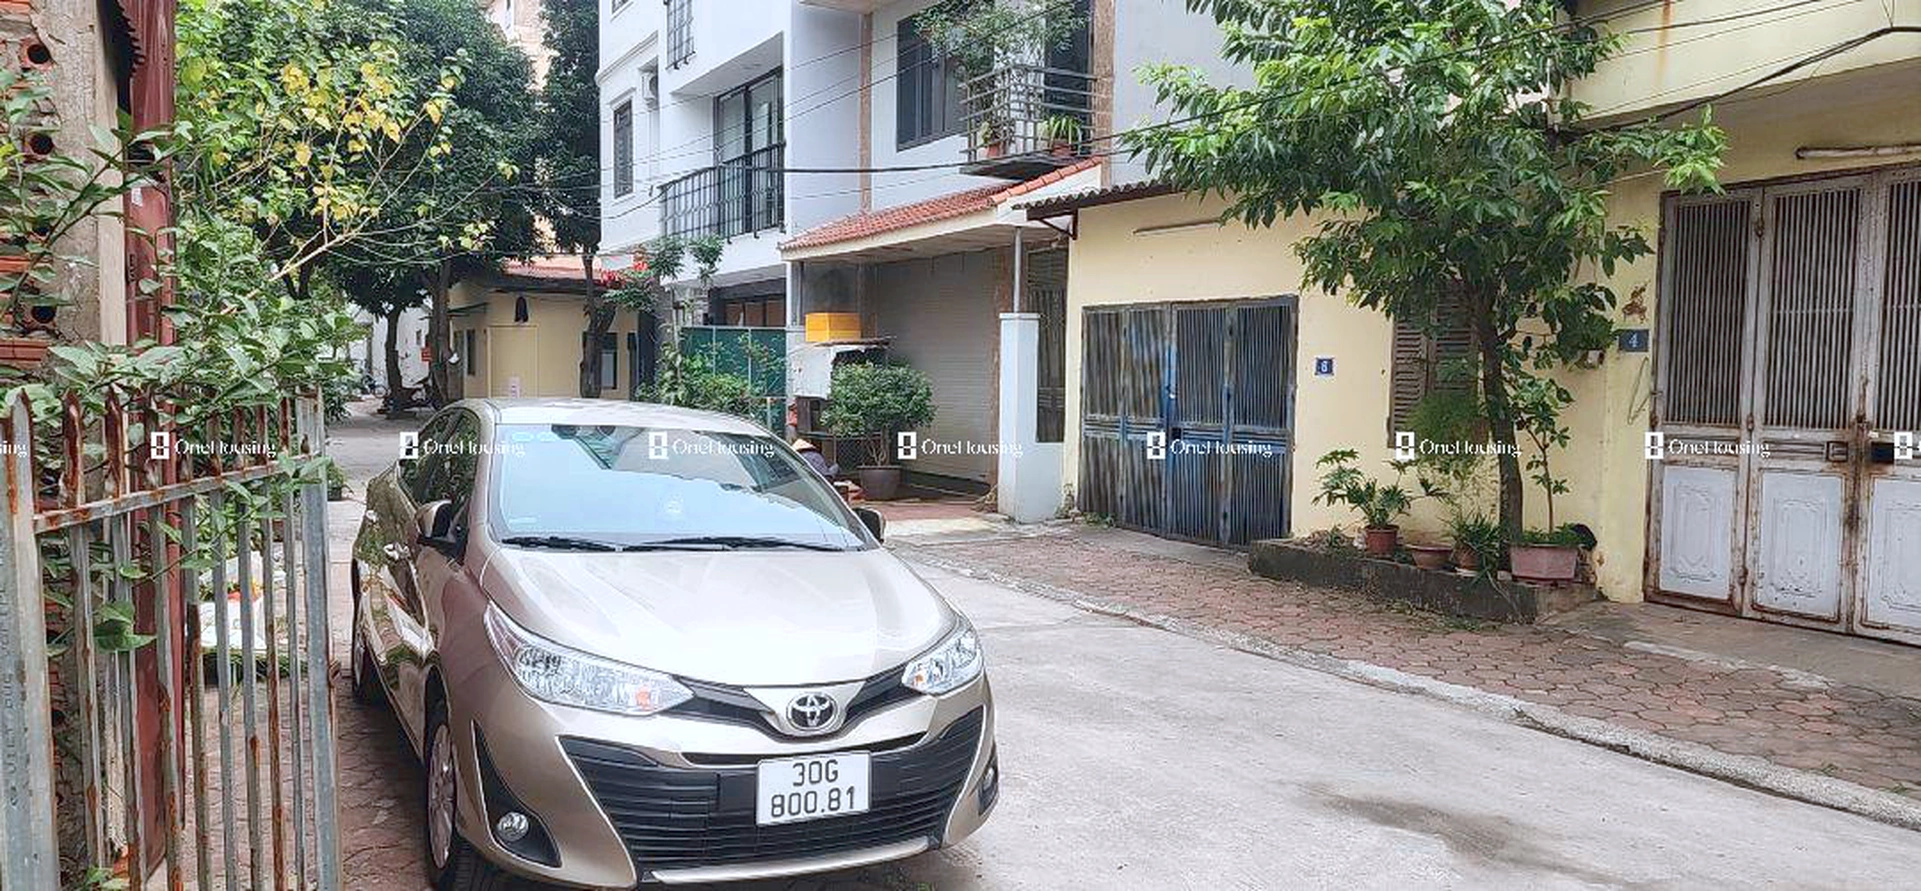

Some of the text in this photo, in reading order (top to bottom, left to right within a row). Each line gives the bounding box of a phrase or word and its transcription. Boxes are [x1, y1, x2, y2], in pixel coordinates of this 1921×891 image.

[1628, 332, 1639, 348] 4
[792, 759, 839, 787] 30G
[771, 786, 855, 818] 800.81
